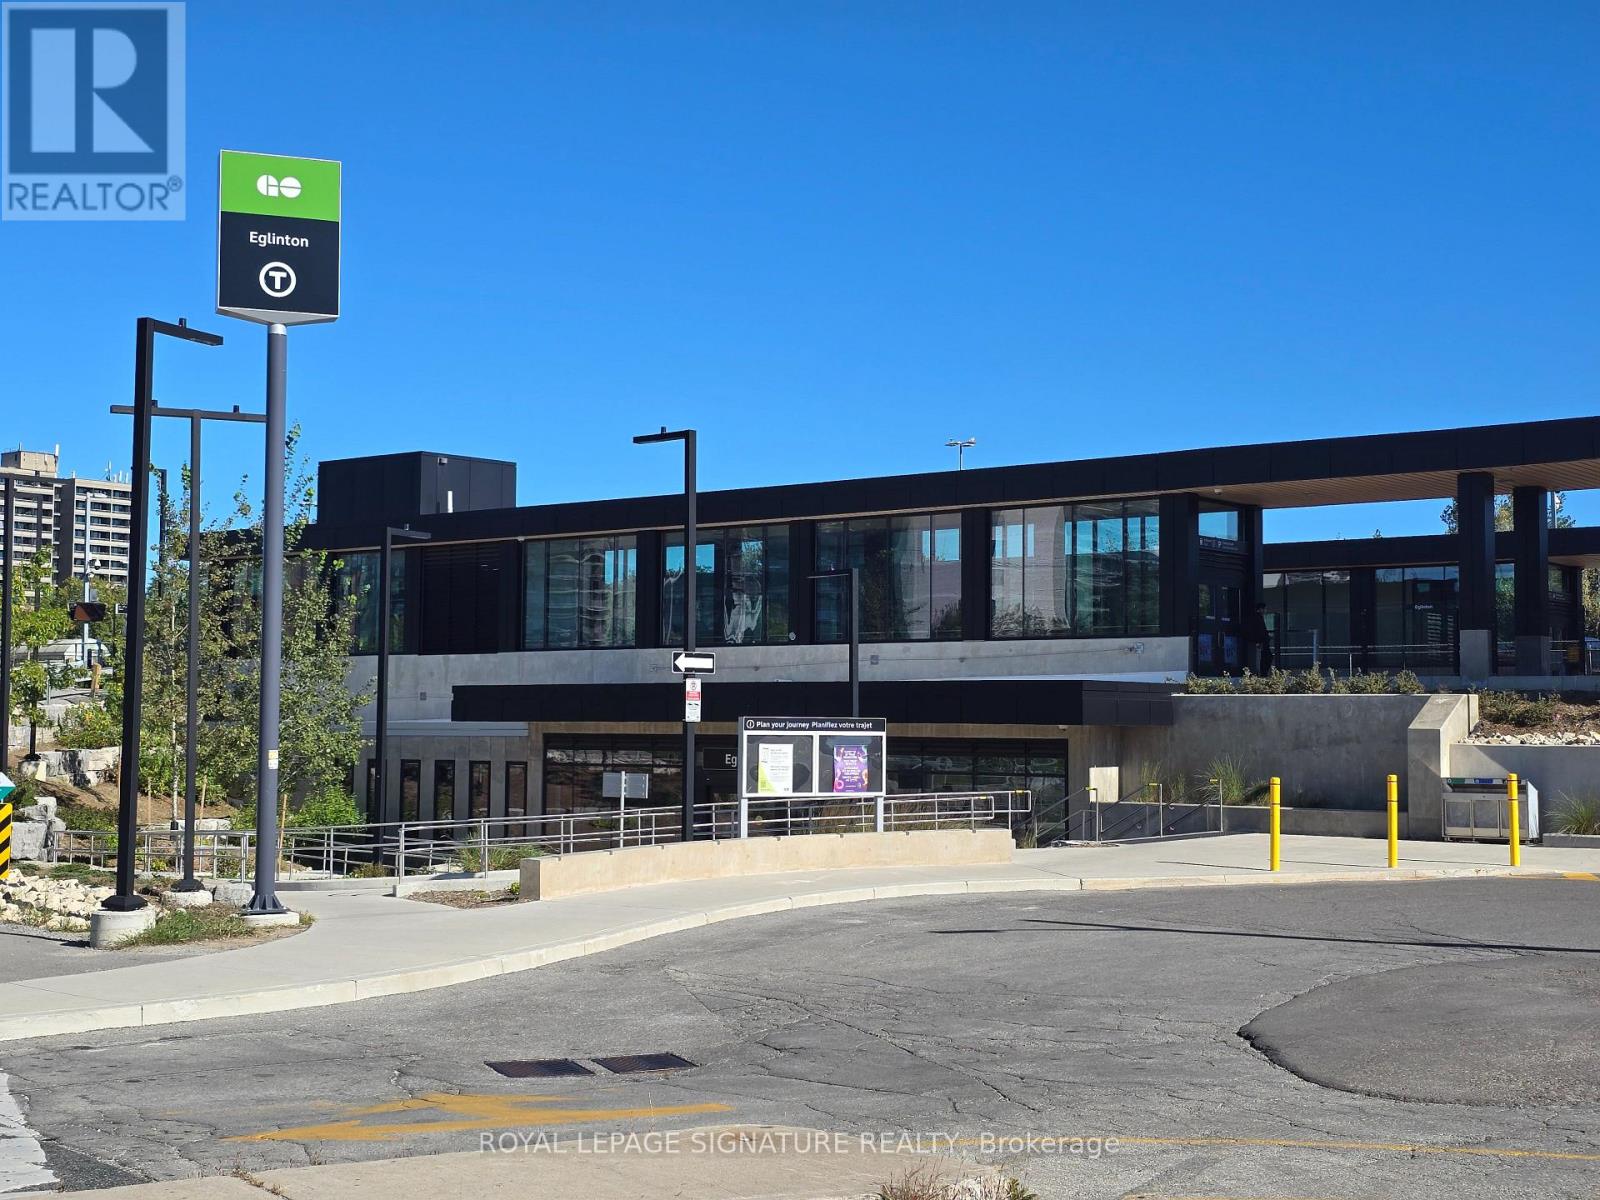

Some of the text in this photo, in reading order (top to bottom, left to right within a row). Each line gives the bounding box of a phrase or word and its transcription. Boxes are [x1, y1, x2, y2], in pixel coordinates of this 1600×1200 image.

[256, 174, 302, 198] GO
[249, 231, 309, 248] Eglinton
[771, 721, 786, 729] your
[786, 721, 810, 729] journey
[725, 753, 737, 768] Eg
